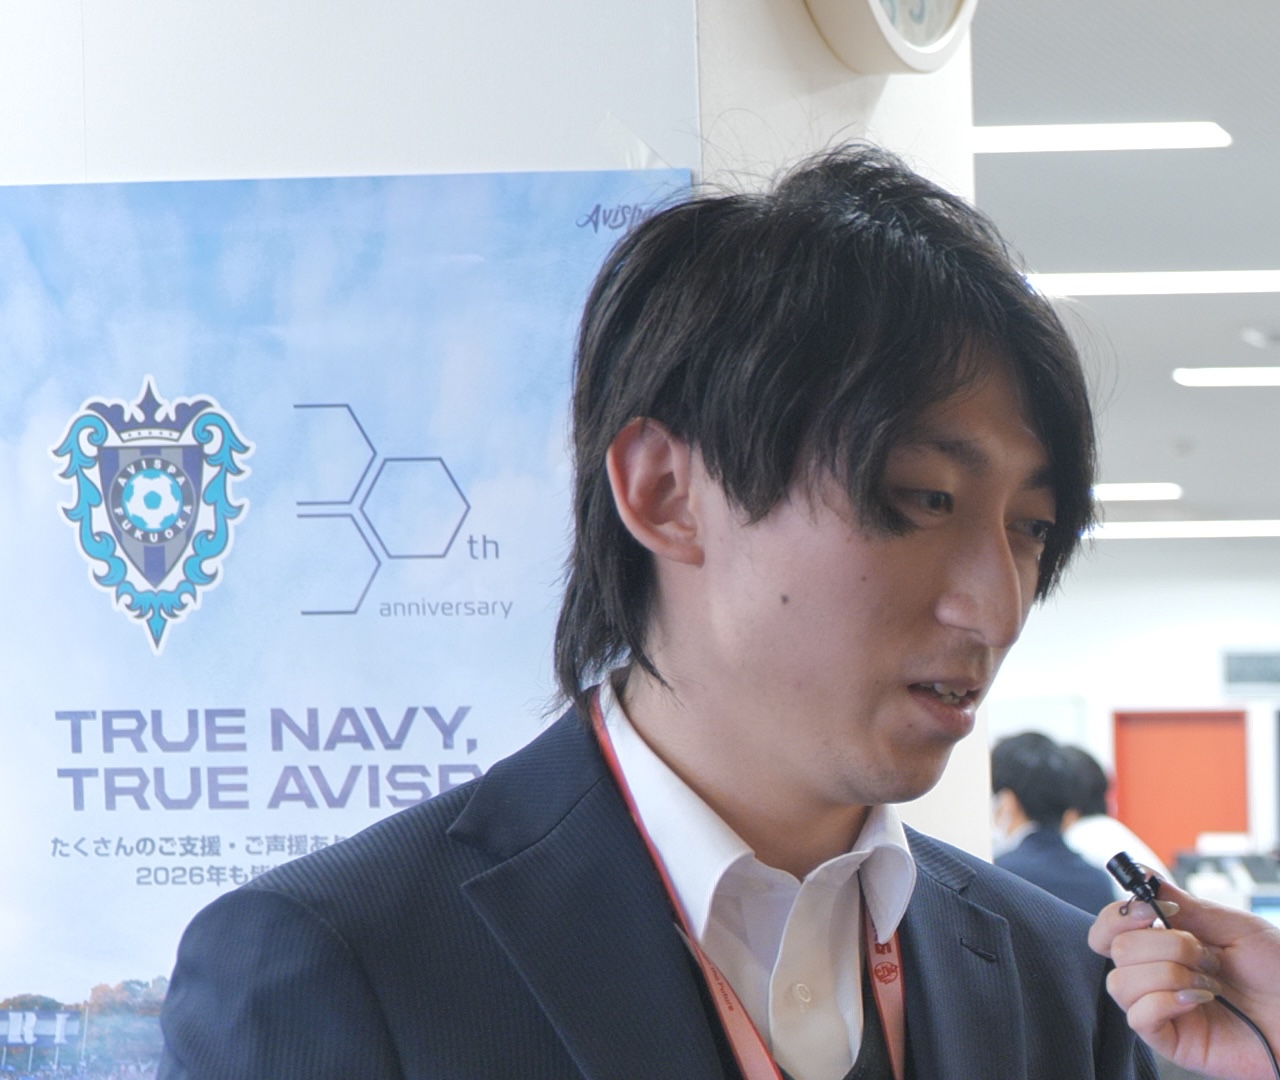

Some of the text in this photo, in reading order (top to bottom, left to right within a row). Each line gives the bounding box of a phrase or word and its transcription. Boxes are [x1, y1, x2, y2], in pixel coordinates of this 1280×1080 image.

[117, 459, 186, 488] AVISPA
[113, 505, 193, 544] FUKUOKA
[379, 597, 514, 618] anniversary
[55, 706, 478, 755] TRUE NAVY,
[57, 764, 484, 811] TRUE AVISP
[51, 834, 348, 858] たくさんのご支援・ご声援あ
